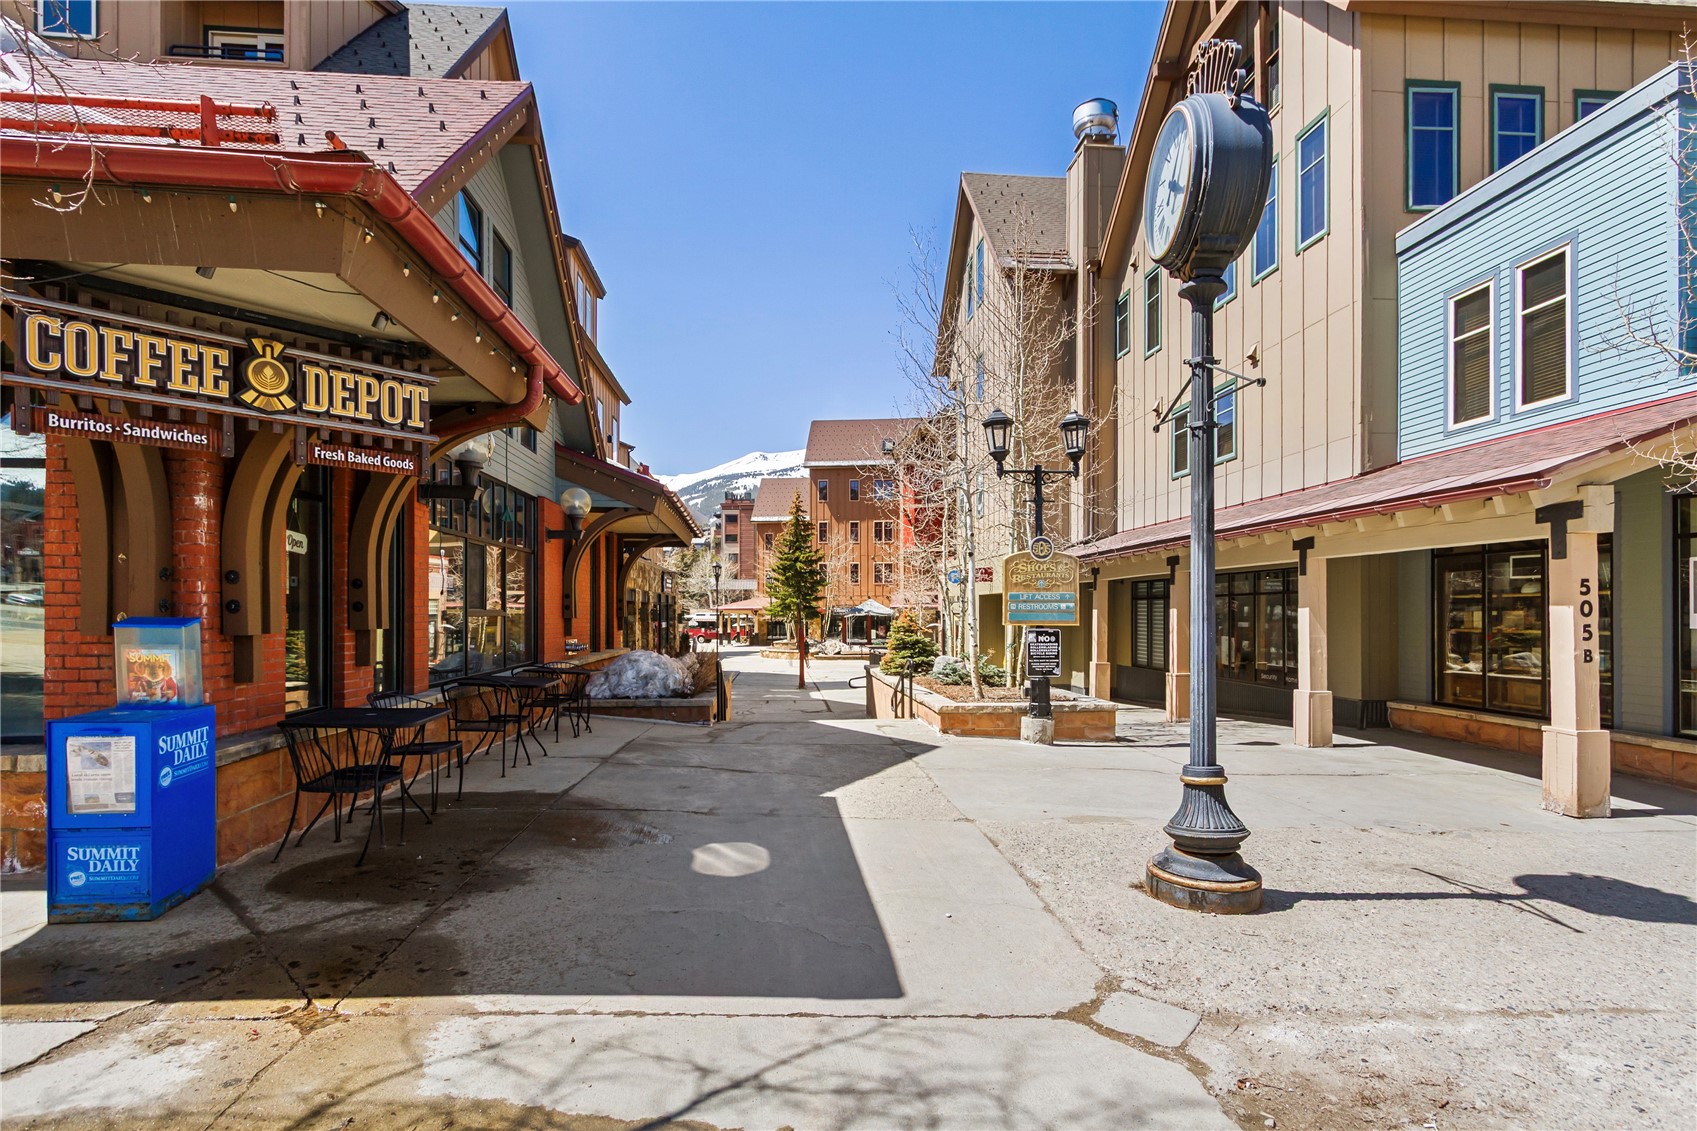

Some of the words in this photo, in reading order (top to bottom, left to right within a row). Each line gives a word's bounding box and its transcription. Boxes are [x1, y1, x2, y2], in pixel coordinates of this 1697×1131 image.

[25, 315, 231, 398] COFFEE
[302, 363, 430, 429] DEPOT
[48, 413, 113, 433] Burritos
[123, 422, 208, 444] Sandwiches
[314, 446, 344, 462] Fresh
[347, 451, 381, 466] Baked
[383, 456, 414, 470] Goods
[287, 534, 304, 549] Open
[1019, 562, 1057, 573] SHOPS
[1012, 572, 1070, 583] RESTAURANTS
[1038, 635, 1050, 643] NO
[129, 653, 171, 663] SUMMIT
[159, 726, 209, 755] SUMMIT
[174, 741, 209, 766] DAILY
[67, 846, 140, 861] SUMMIT
[88, 859, 140, 873] DAILY
